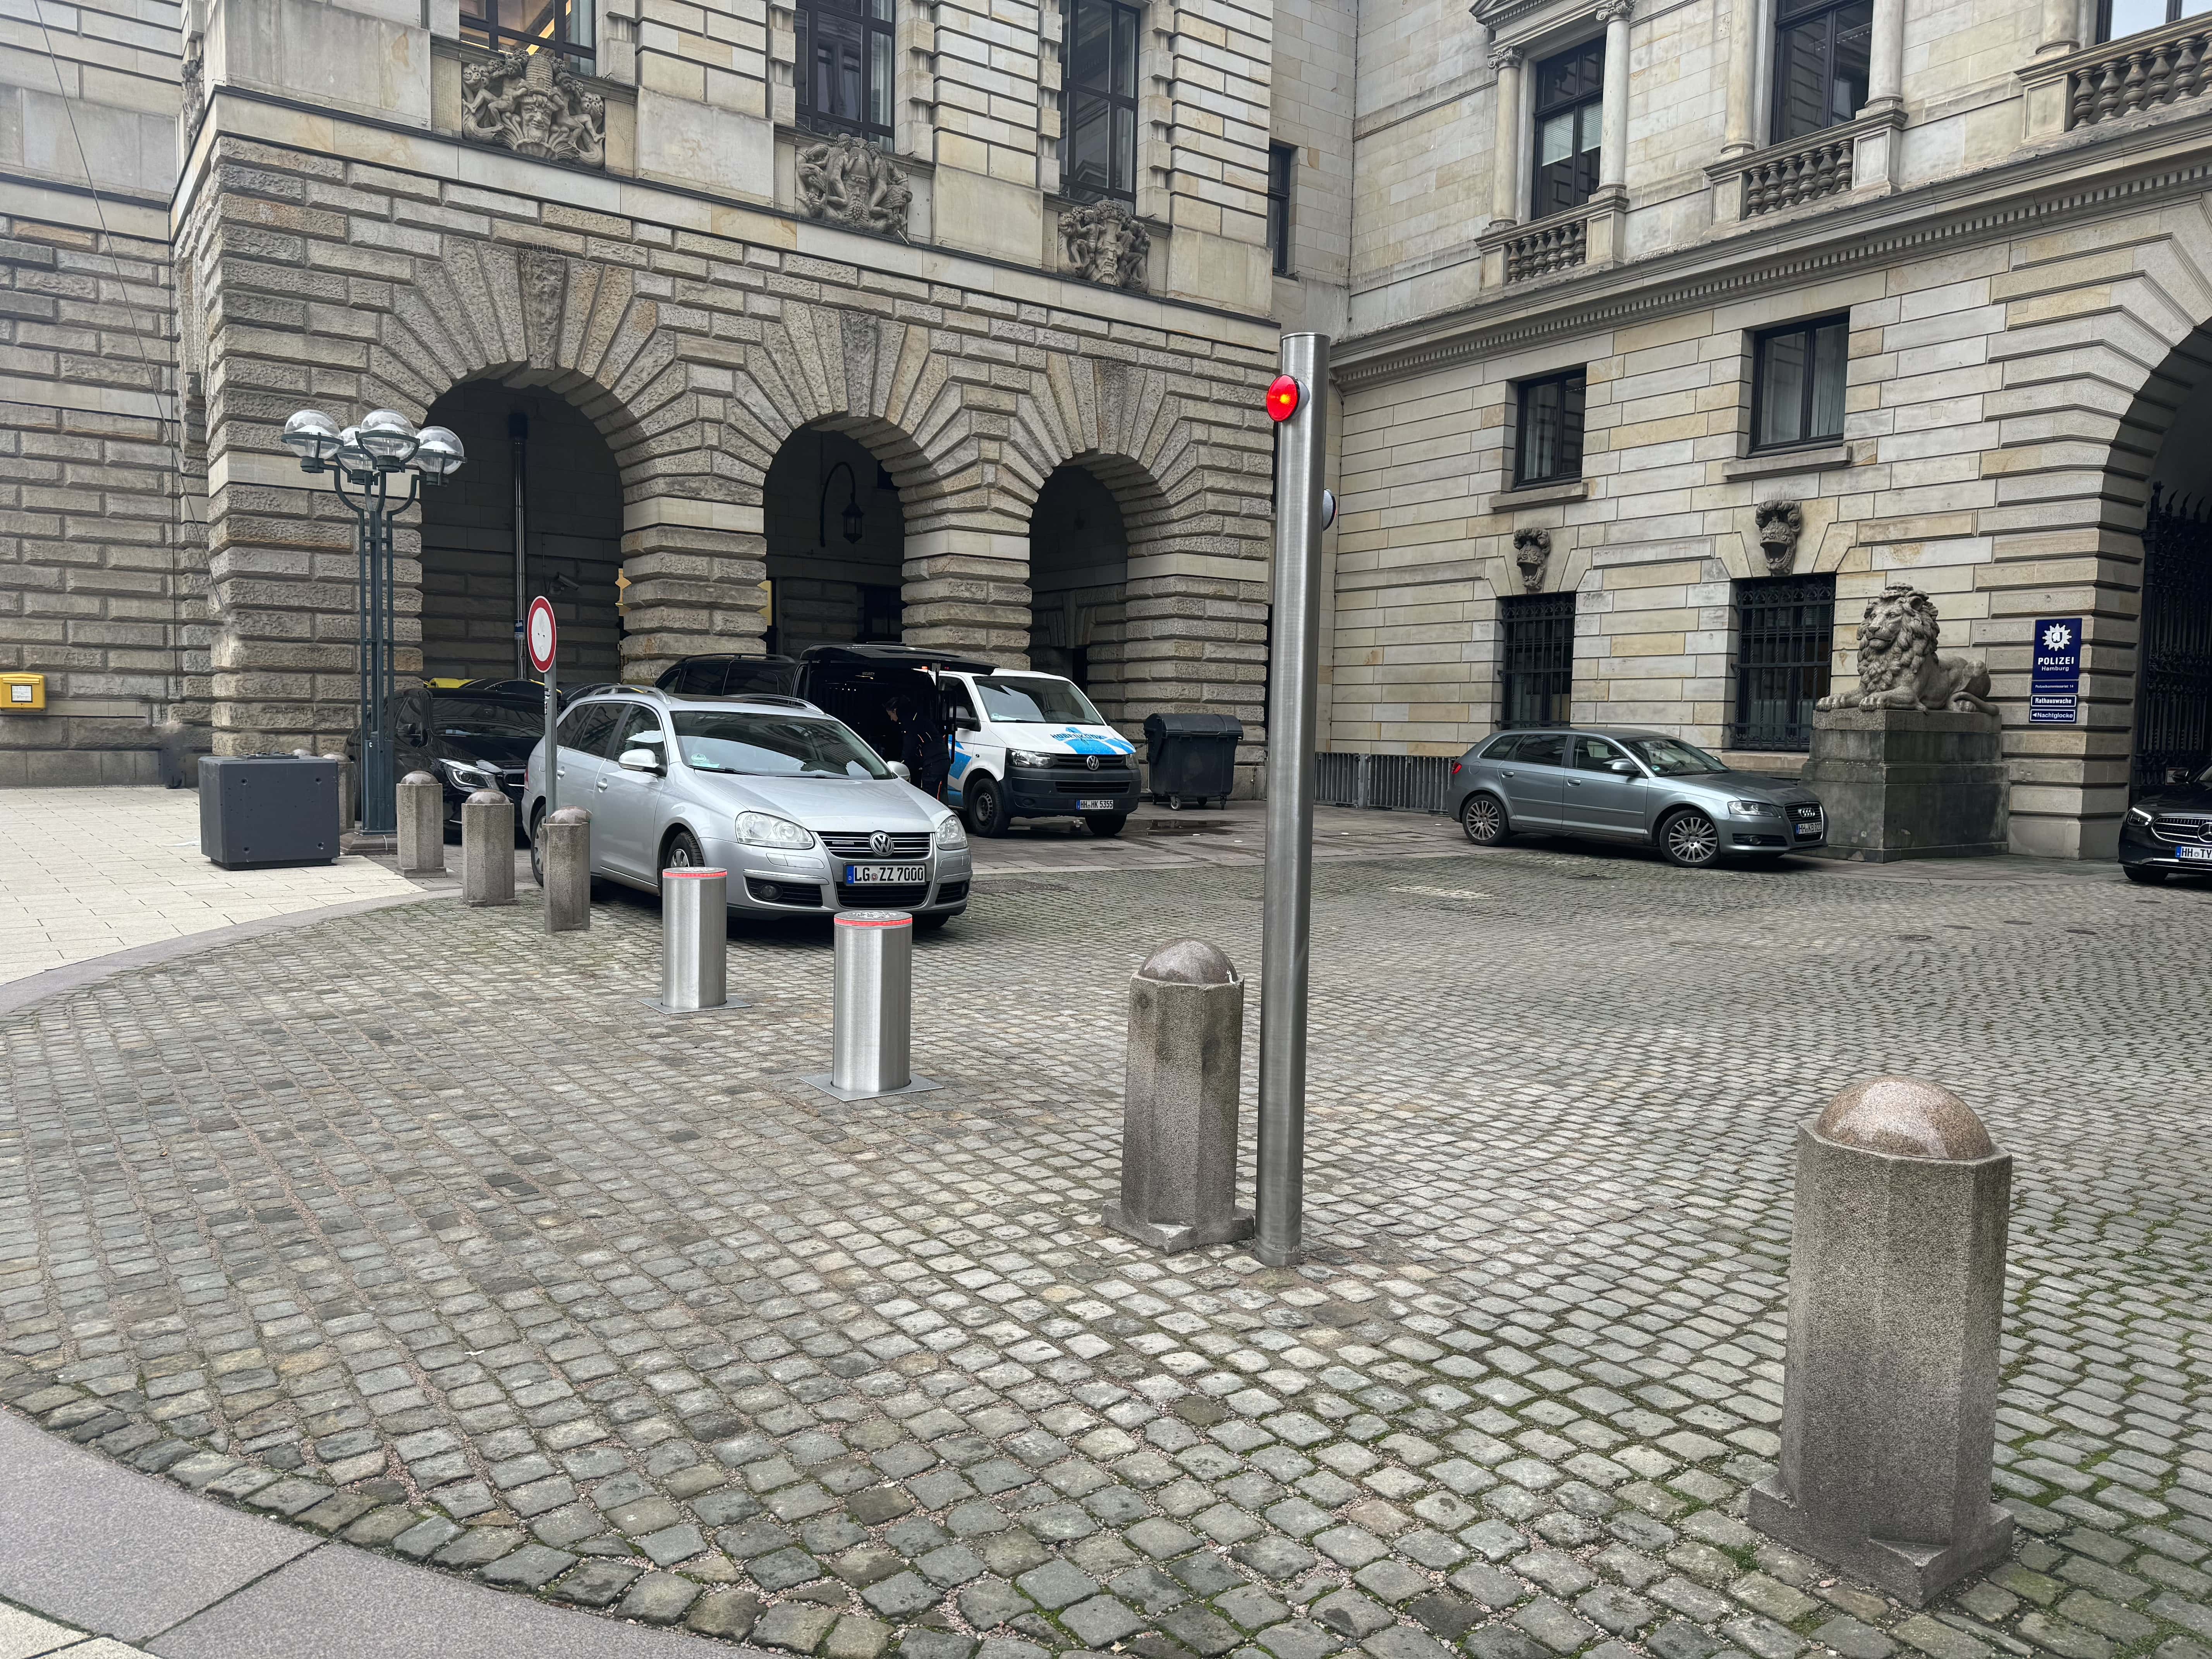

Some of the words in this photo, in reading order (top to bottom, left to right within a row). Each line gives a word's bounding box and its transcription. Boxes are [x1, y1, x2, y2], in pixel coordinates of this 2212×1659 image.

[2038, 657, 2074, 665] POLIZEI
[1799, 824, 1806, 833] HH
[2181, 848, 2193, 857] HH
[2200, 849, 2212, 858] TY
[854, 867, 870, 881] LG
[879, 867, 894, 881] ZZ
[897, 867, 923, 881] 7000
